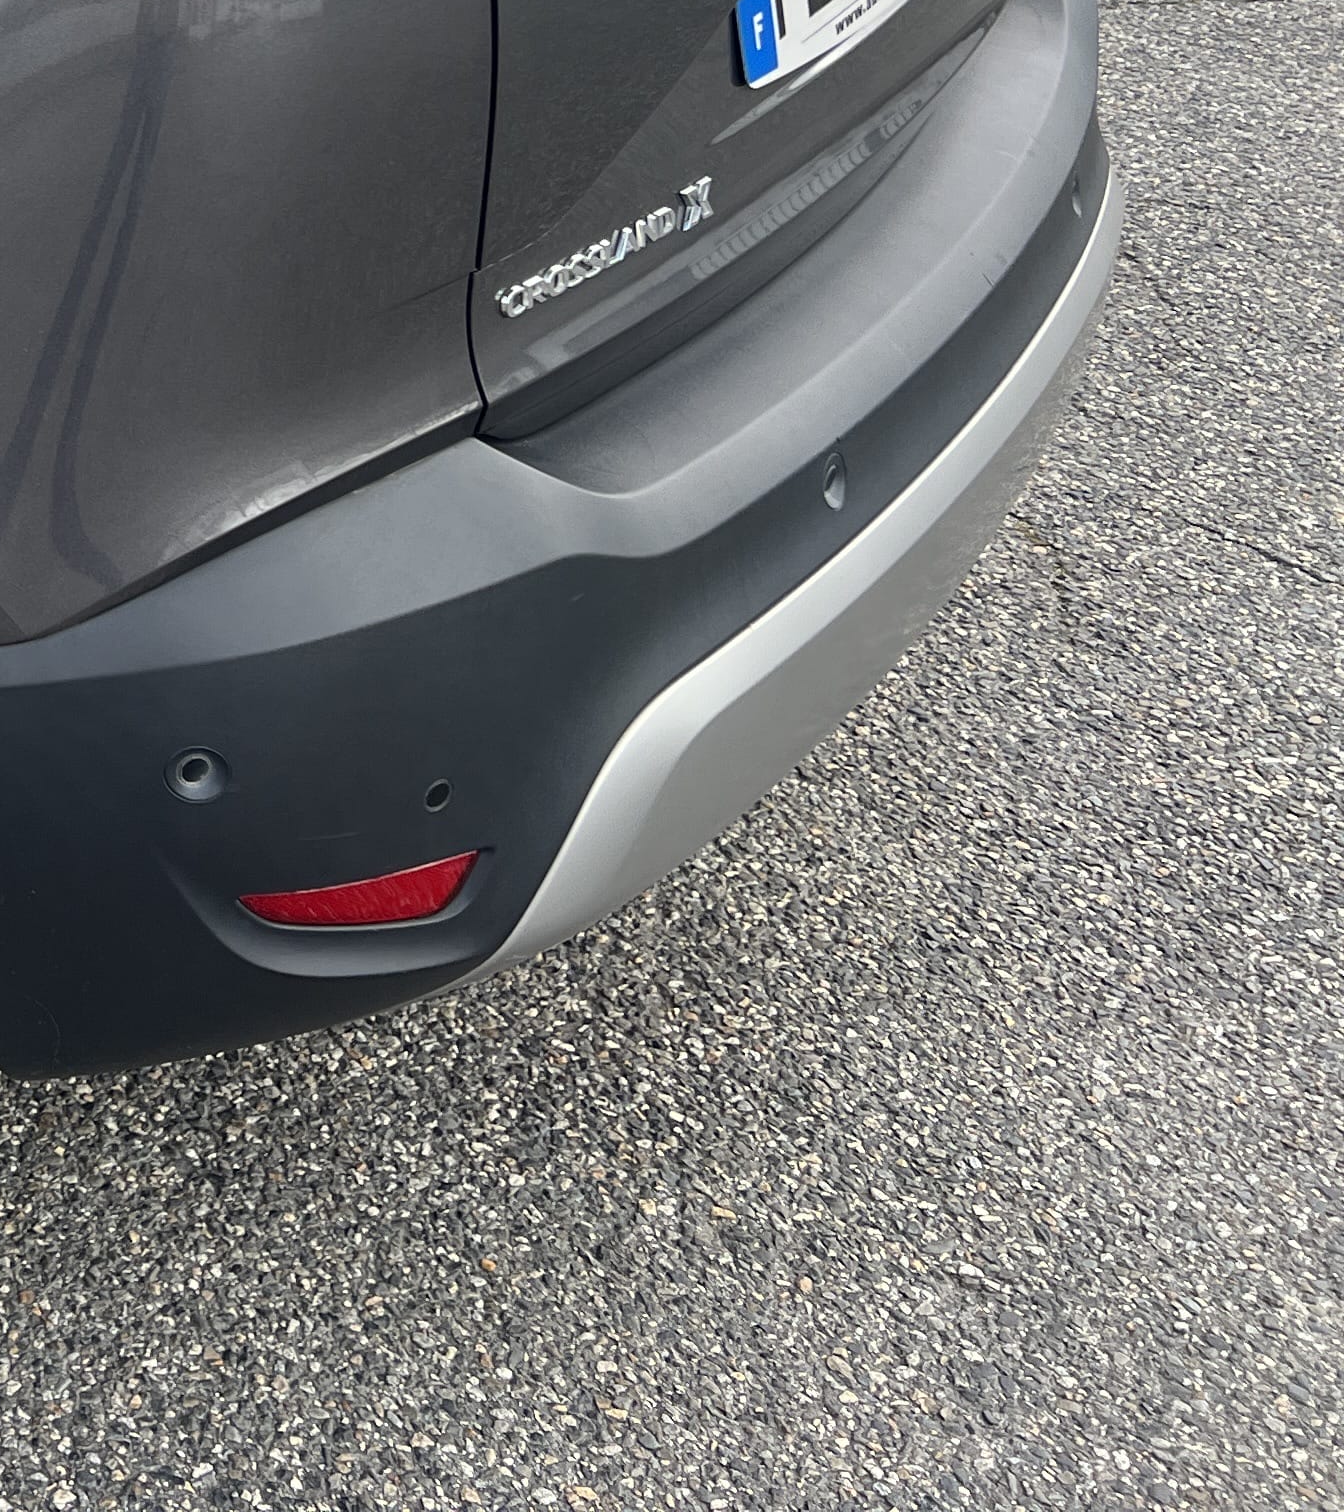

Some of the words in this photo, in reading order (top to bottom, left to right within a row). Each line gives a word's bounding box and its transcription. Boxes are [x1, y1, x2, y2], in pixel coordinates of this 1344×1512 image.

[753, 11, 765, 51] F
[496, 206, 676, 319] CROSSLAND
[677, 175, 714, 232] X
